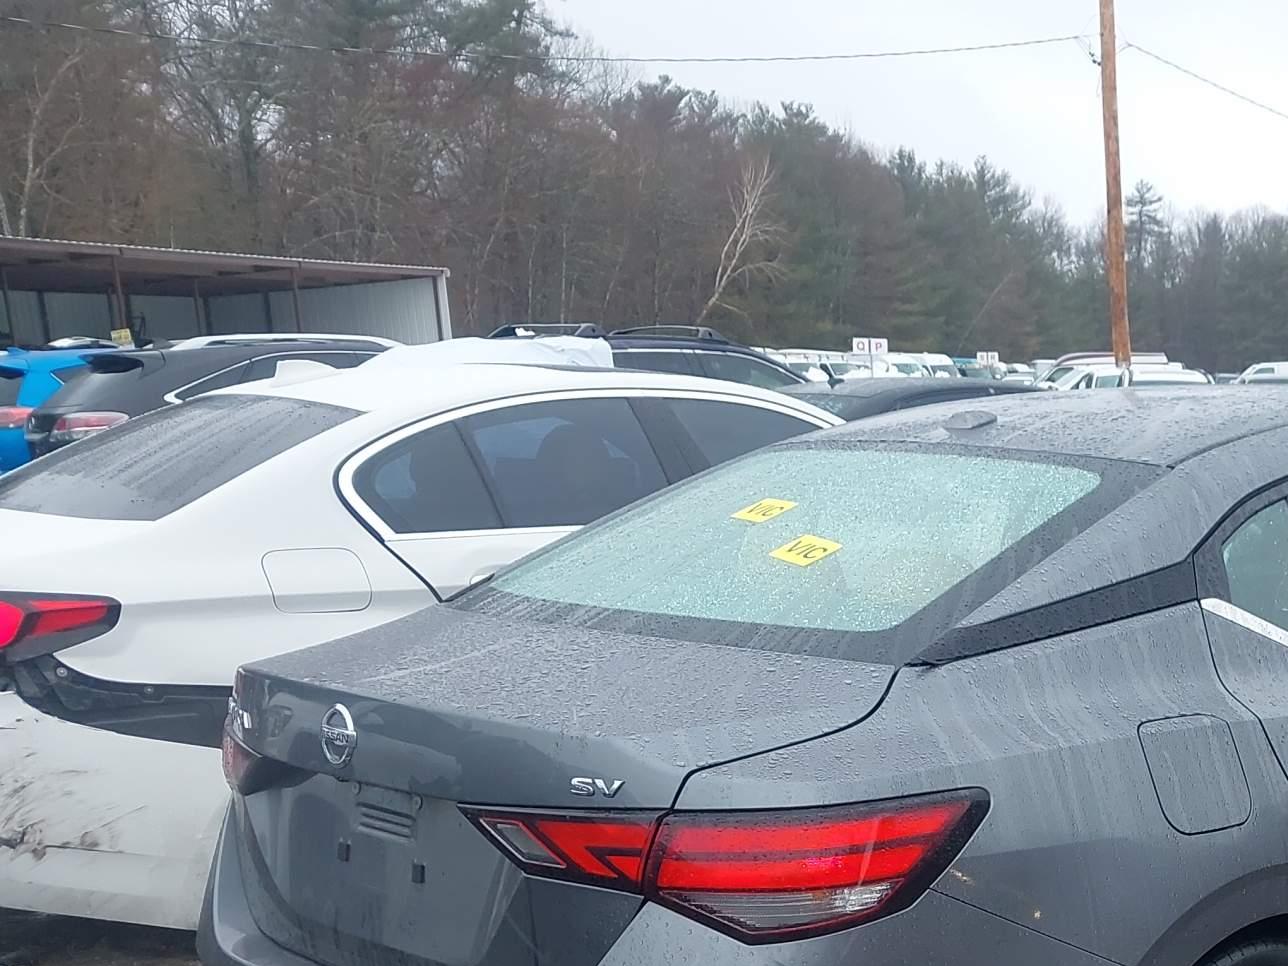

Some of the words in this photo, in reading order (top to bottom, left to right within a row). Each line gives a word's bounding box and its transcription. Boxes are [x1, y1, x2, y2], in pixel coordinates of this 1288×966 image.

[856, 341, 866, 351] Q
[875, 341, 883, 351] P
[746, 503, 785, 517] VIC
[786, 540, 828, 559] VIC
[570, 777, 625, 797] SV
